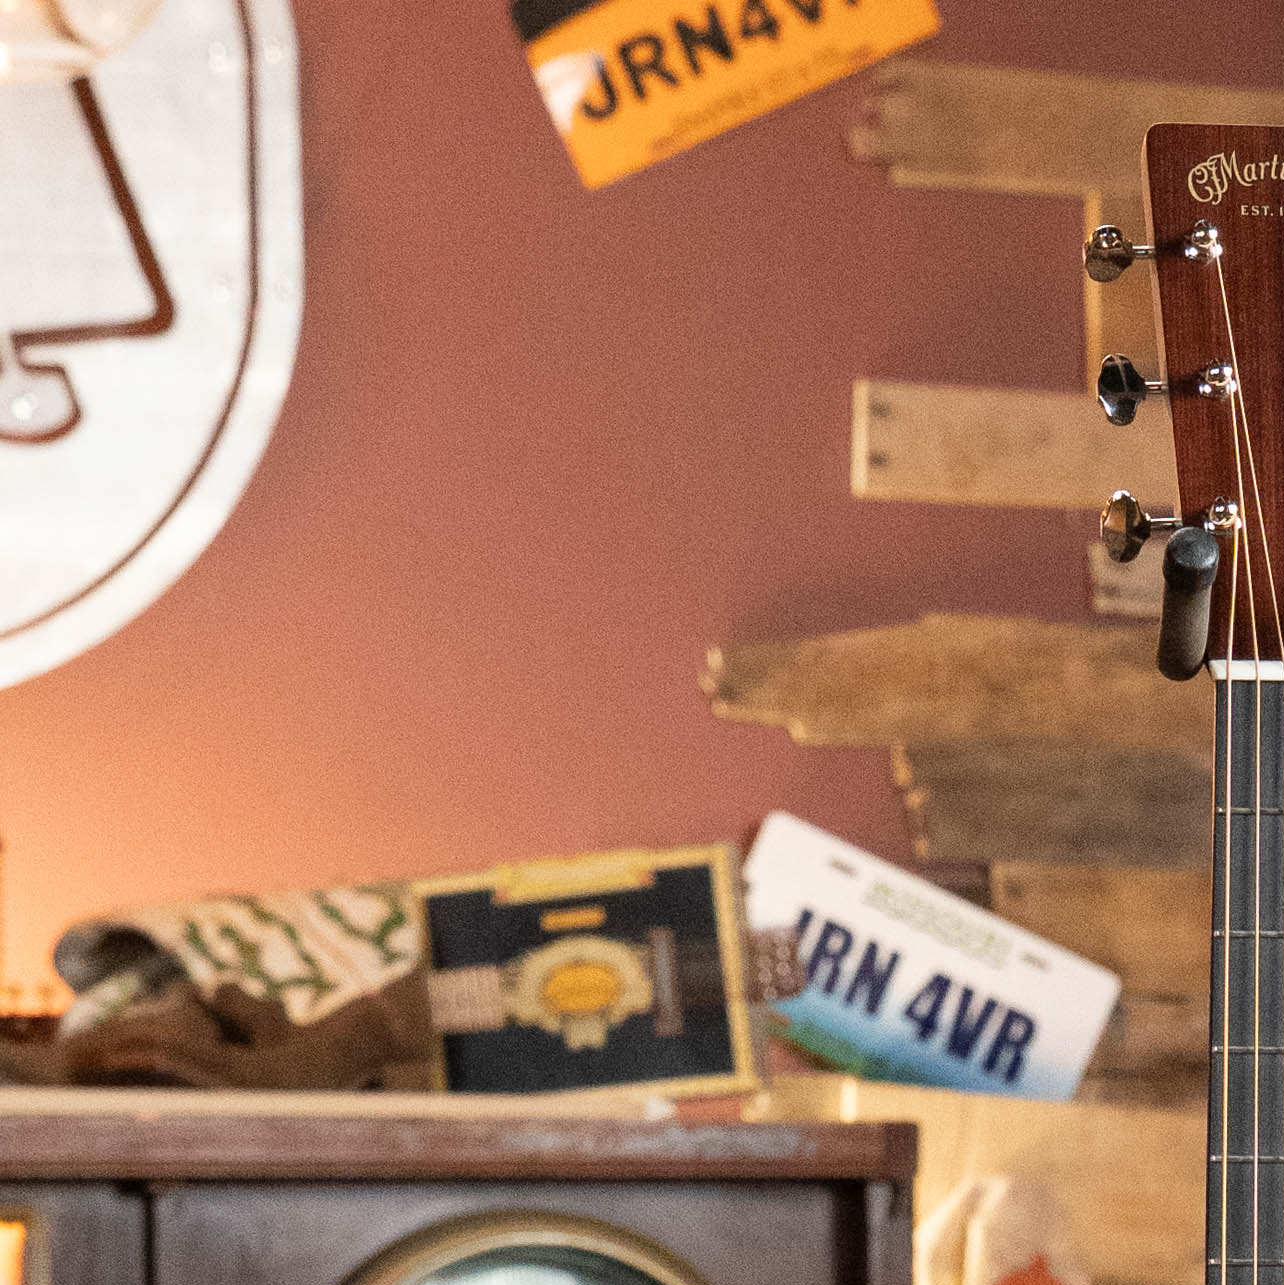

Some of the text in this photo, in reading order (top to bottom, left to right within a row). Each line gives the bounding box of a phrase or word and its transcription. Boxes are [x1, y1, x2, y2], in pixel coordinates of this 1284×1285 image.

[580, 0, 858, 120] JRN4
[1240, 204, 1274, 217] EST.
[905, 972, 1037, 1084] 4VR
